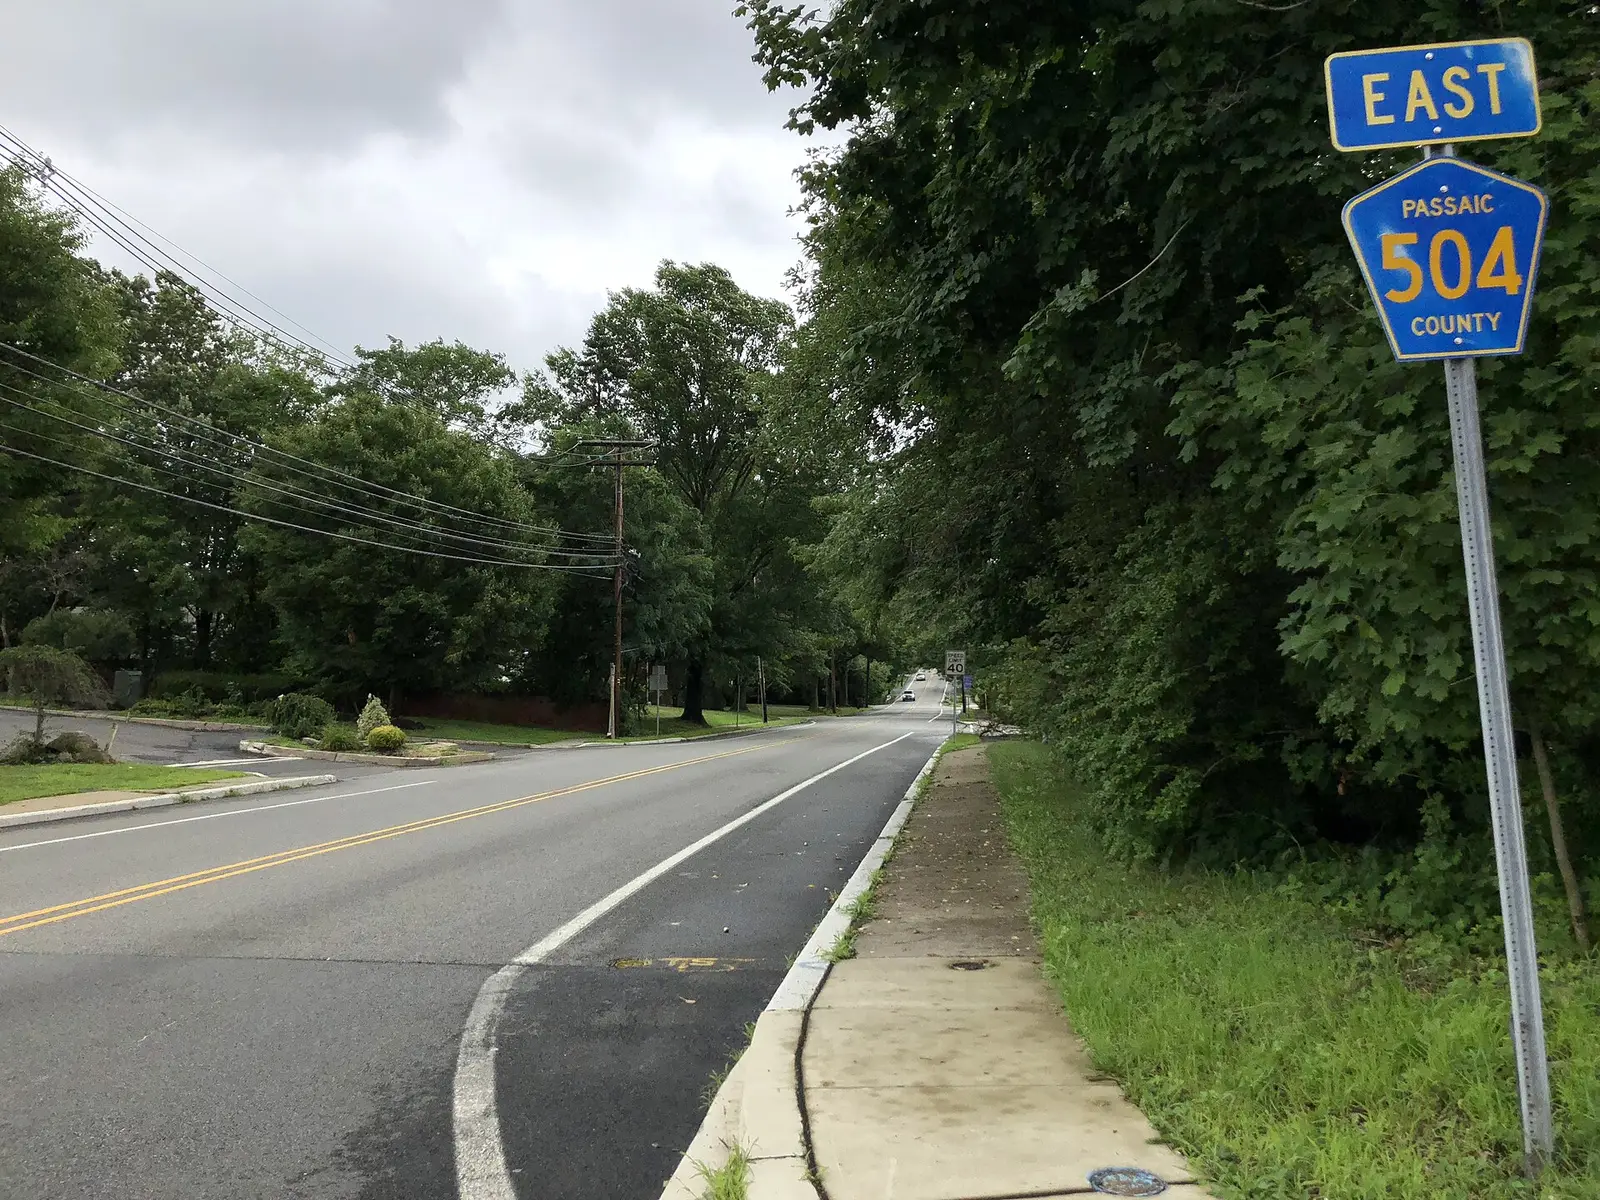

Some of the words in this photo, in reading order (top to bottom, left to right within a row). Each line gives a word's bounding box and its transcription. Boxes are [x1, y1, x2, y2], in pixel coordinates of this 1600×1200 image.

[1362, 63, 1505, 126] EAST
[1402, 194, 1495, 218] PASSAIC
[1381, 226, 1522, 303] 504
[1411, 312, 1502, 336] COUNTY
[947, 663, 964, 673] 40
